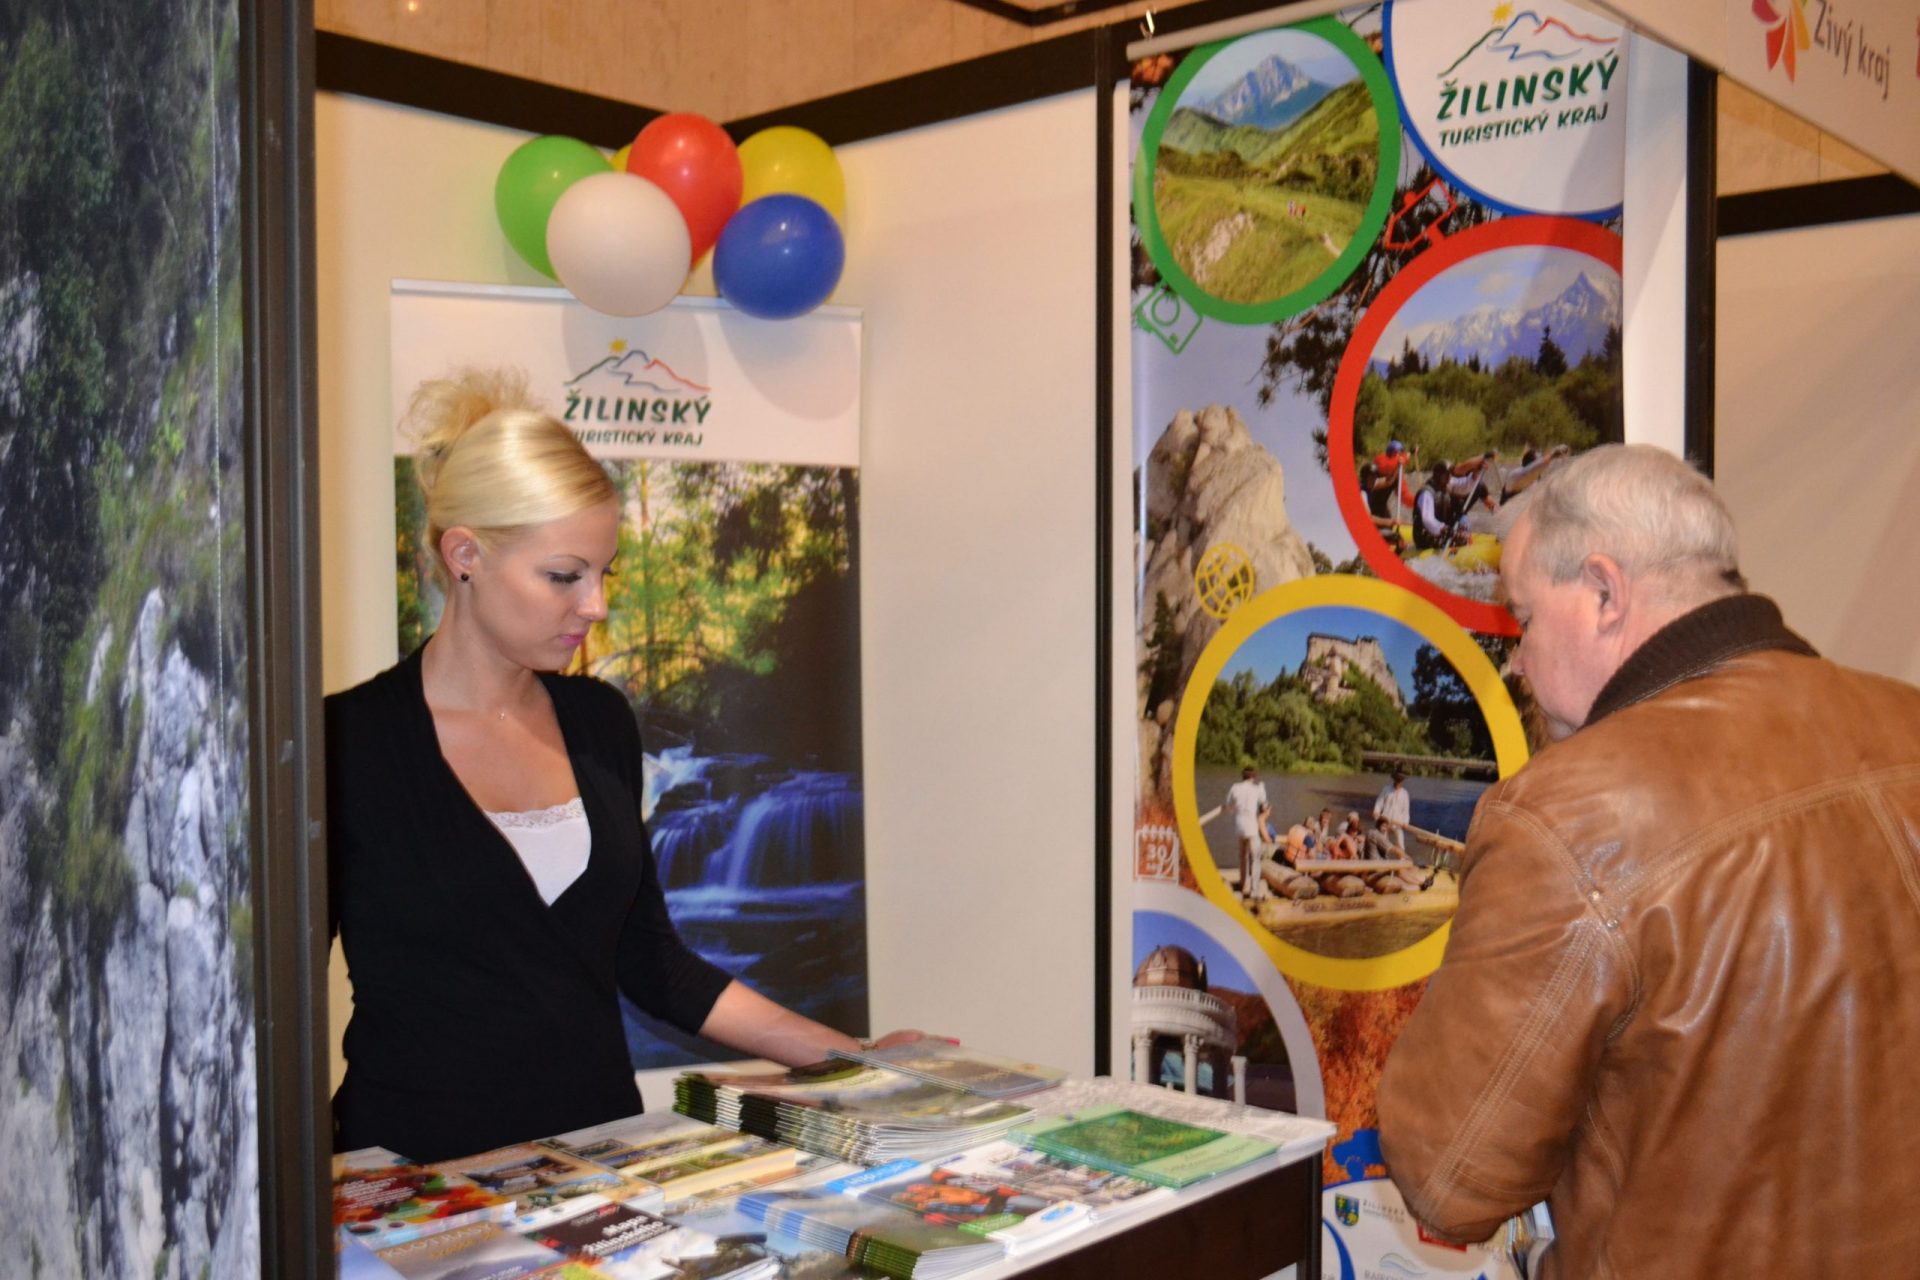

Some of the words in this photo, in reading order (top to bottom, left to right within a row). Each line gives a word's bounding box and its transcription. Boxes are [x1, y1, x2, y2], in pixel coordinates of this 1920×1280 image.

[1437, 47, 1619, 120] ŽILINSKÝ
[1858, 24, 1890, 101] kraj
[1440, 109, 1549, 147] TURISTICKÝ
[1557, 102, 1608, 129] KRAJ
[564, 388, 711, 424] ŽILINSKÝ
[573, 407, 656, 445] URISTICKÝ
[663, 412, 703, 446] KRAJ
